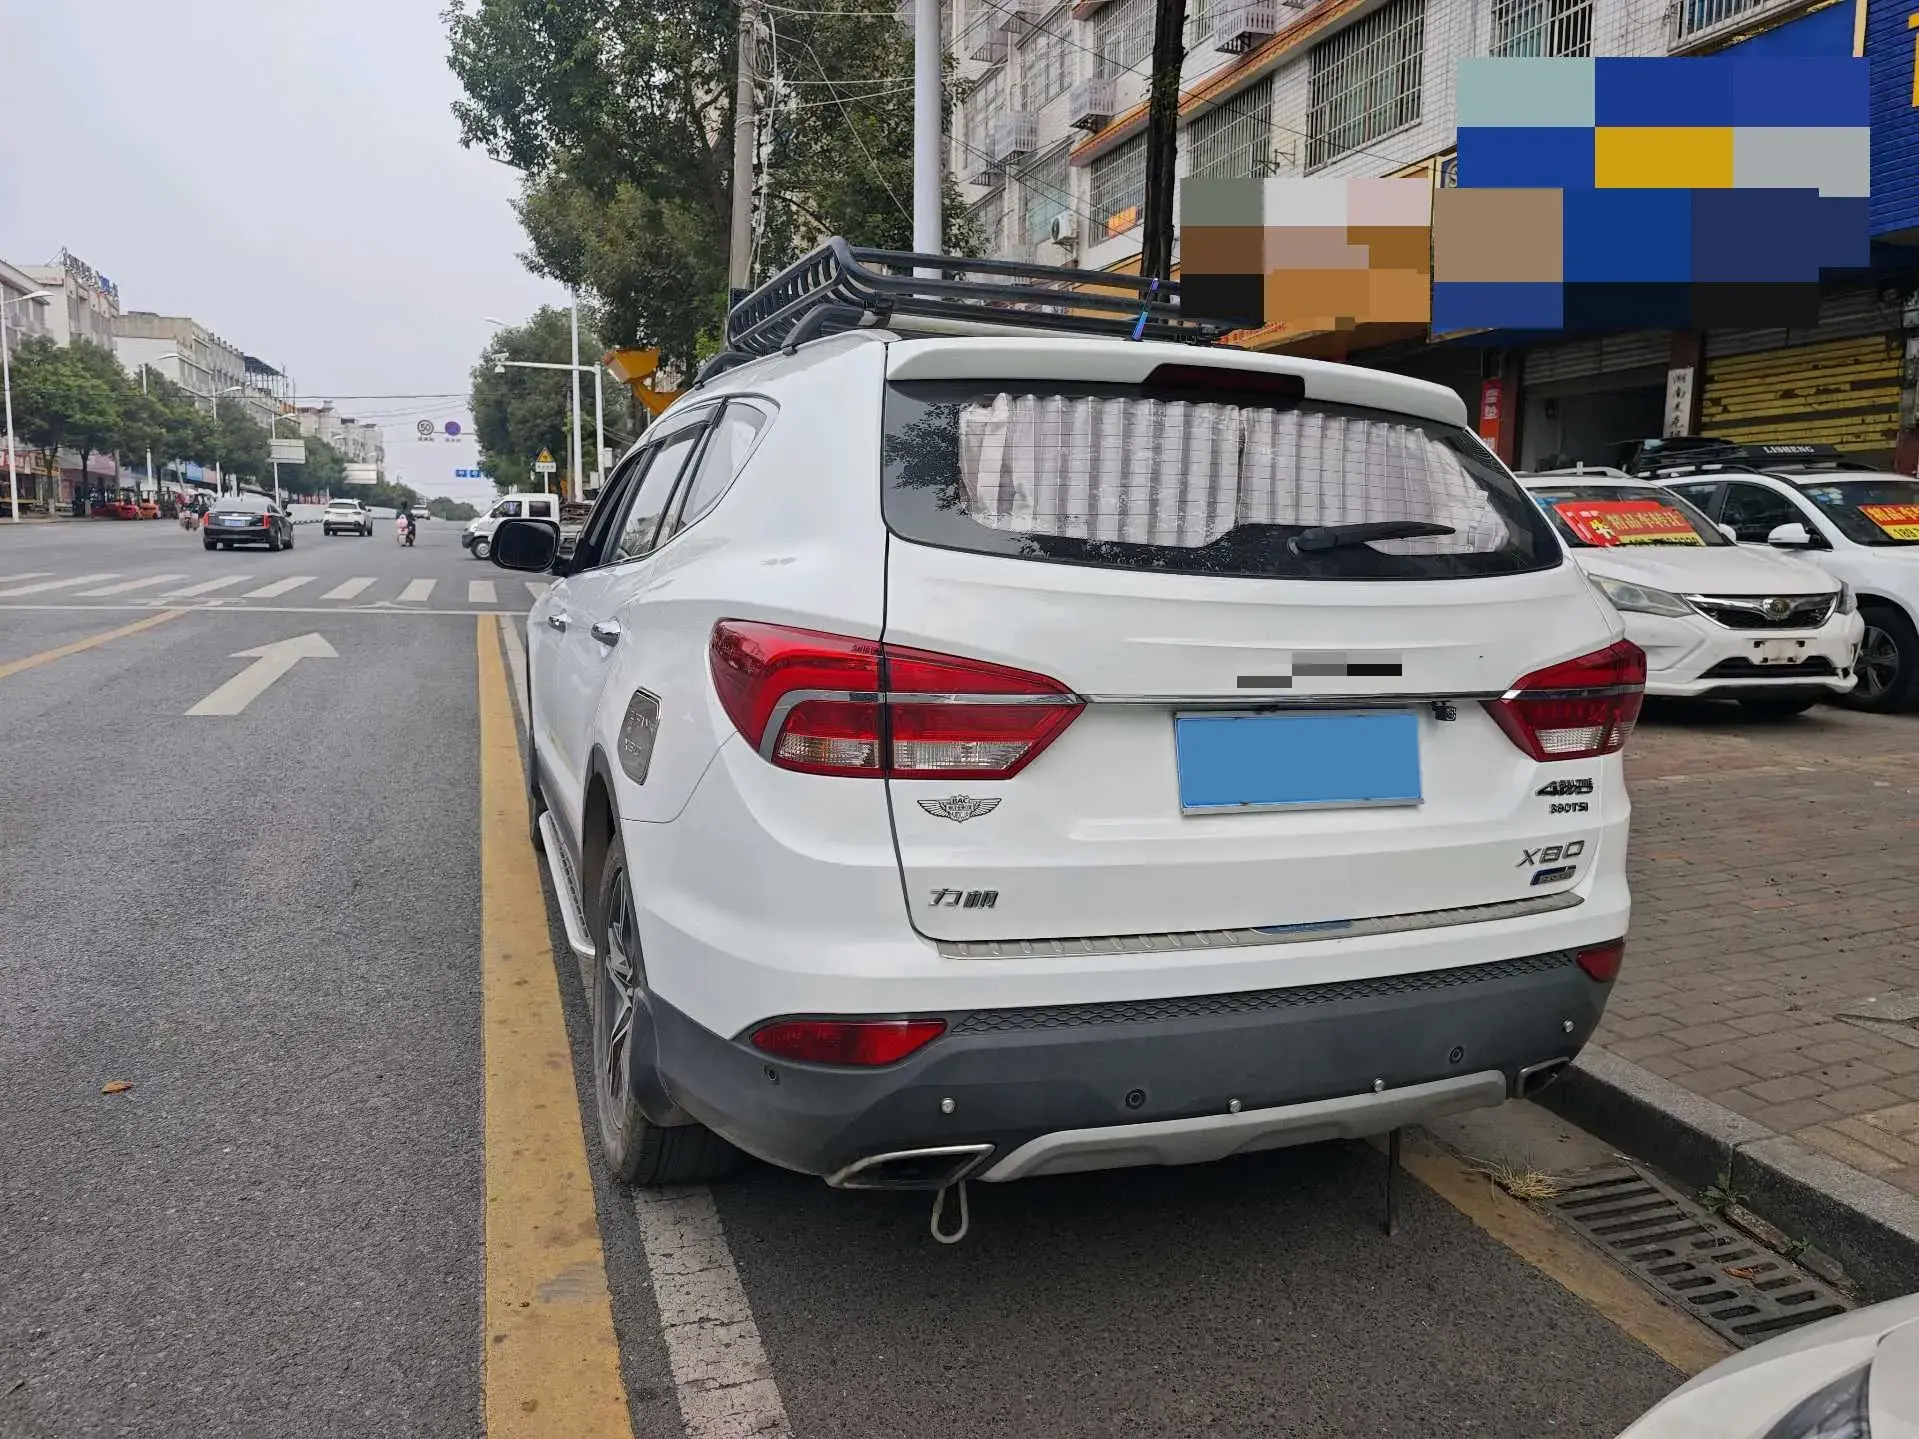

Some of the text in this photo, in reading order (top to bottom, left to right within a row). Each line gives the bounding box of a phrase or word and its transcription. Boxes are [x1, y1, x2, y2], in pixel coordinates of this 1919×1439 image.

[1606, 511, 1684, 530] 精品车转让
[1516, 840, 1585, 867] X80
[928, 888, 999, 909] 力帆
